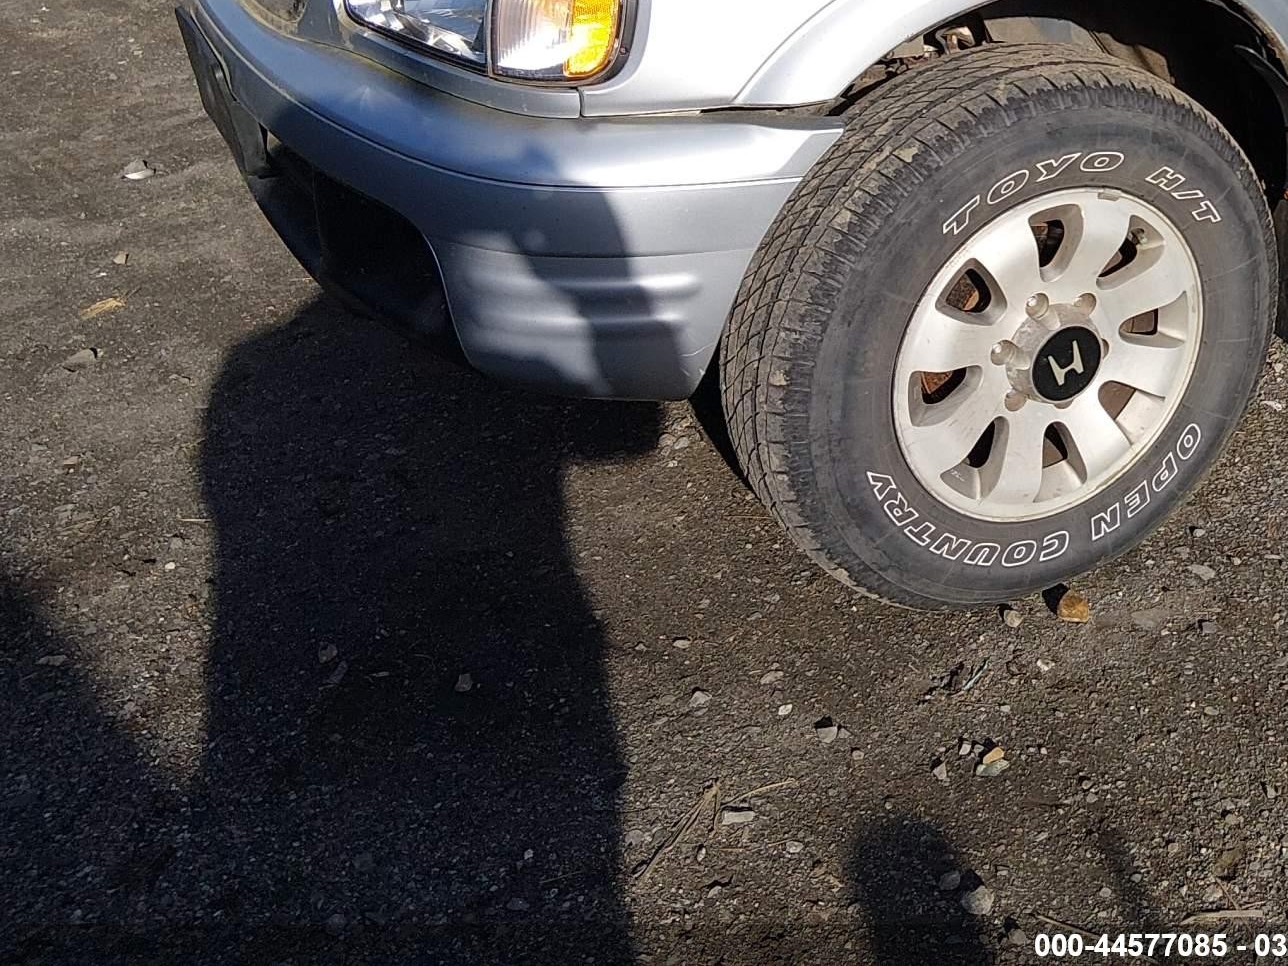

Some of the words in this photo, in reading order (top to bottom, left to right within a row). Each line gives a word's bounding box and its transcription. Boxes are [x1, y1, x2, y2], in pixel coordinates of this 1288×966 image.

[943, 151, 1125, 235] TOYO
[1145, 166, 1222, 224] H/T
[866, 470, 1070, 567] COUNTRY
[1090, 422, 1202, 541] OPEN
